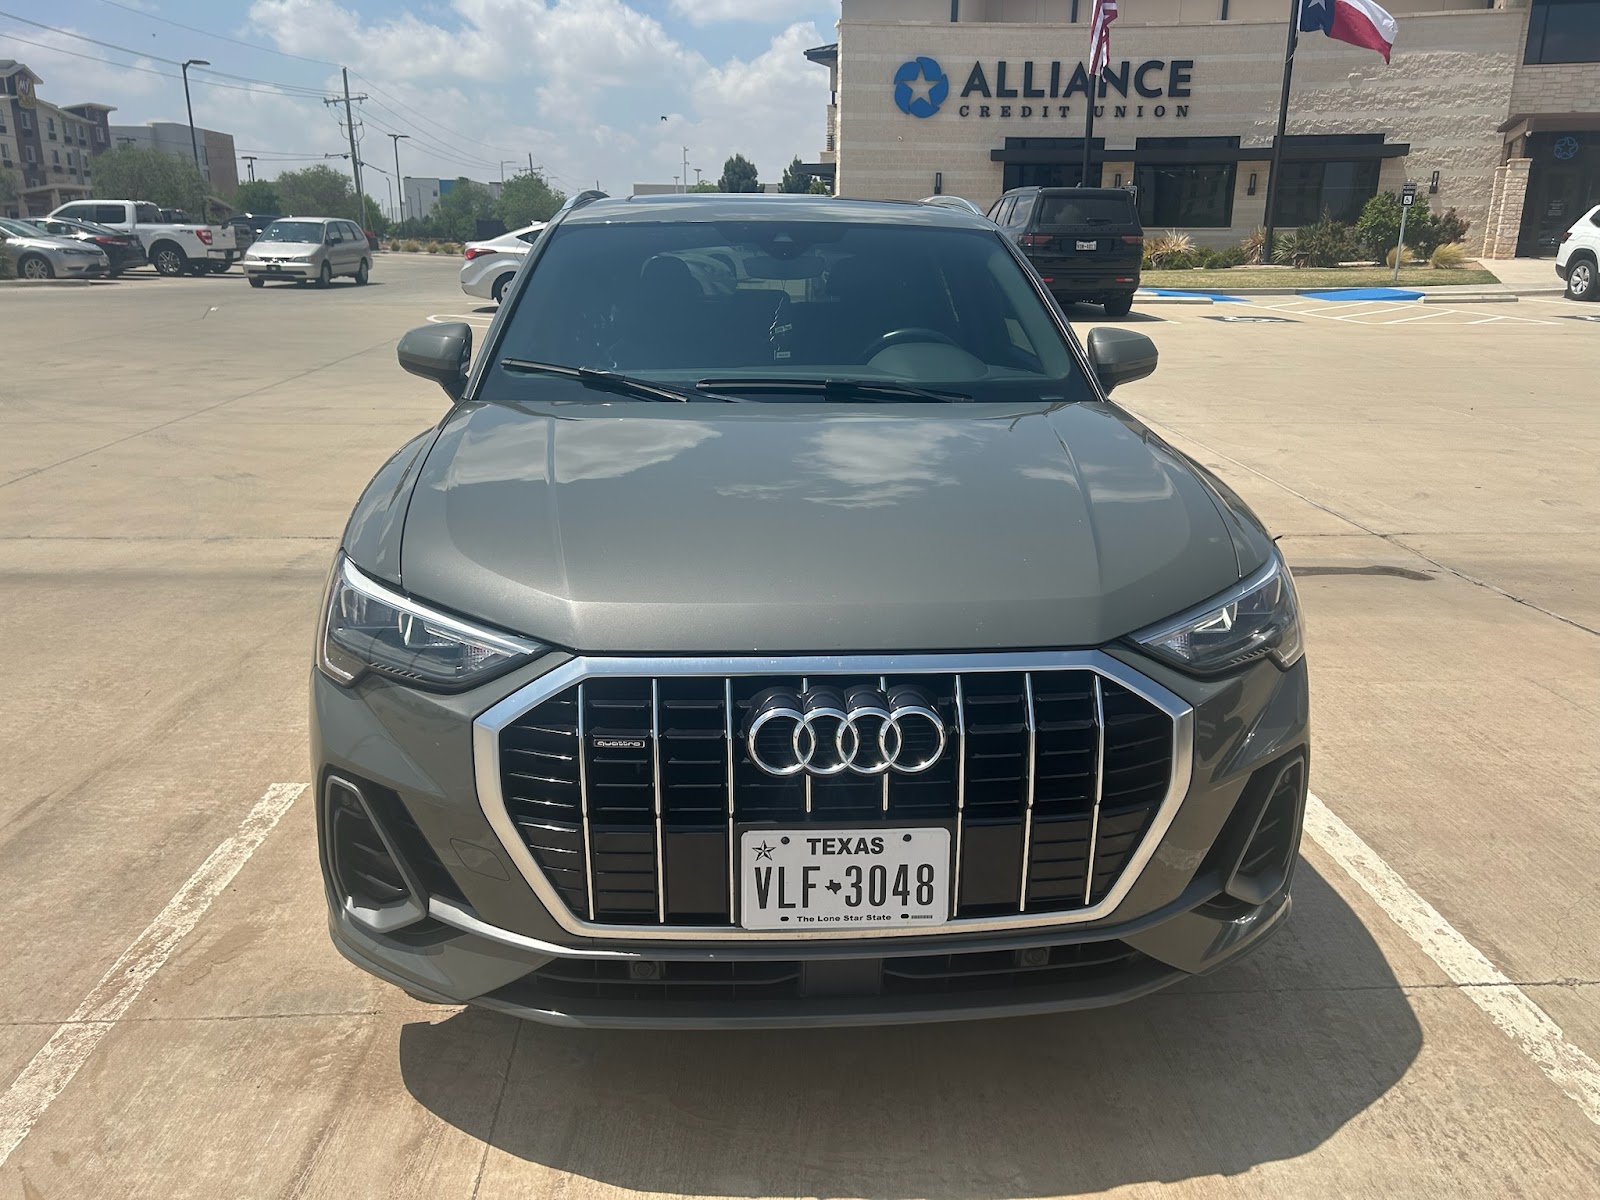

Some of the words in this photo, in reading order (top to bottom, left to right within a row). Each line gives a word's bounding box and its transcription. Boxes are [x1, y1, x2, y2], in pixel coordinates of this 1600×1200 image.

[960, 60, 1194, 99] ALLIANCE
[959, 105, 1070, 118] CREDIT
[1093, 105, 1189, 118] UNION
[806, 837, 885, 856] TEXAS
[754, 865, 821, 910] VLF
[844, 863, 935, 908] 3048
